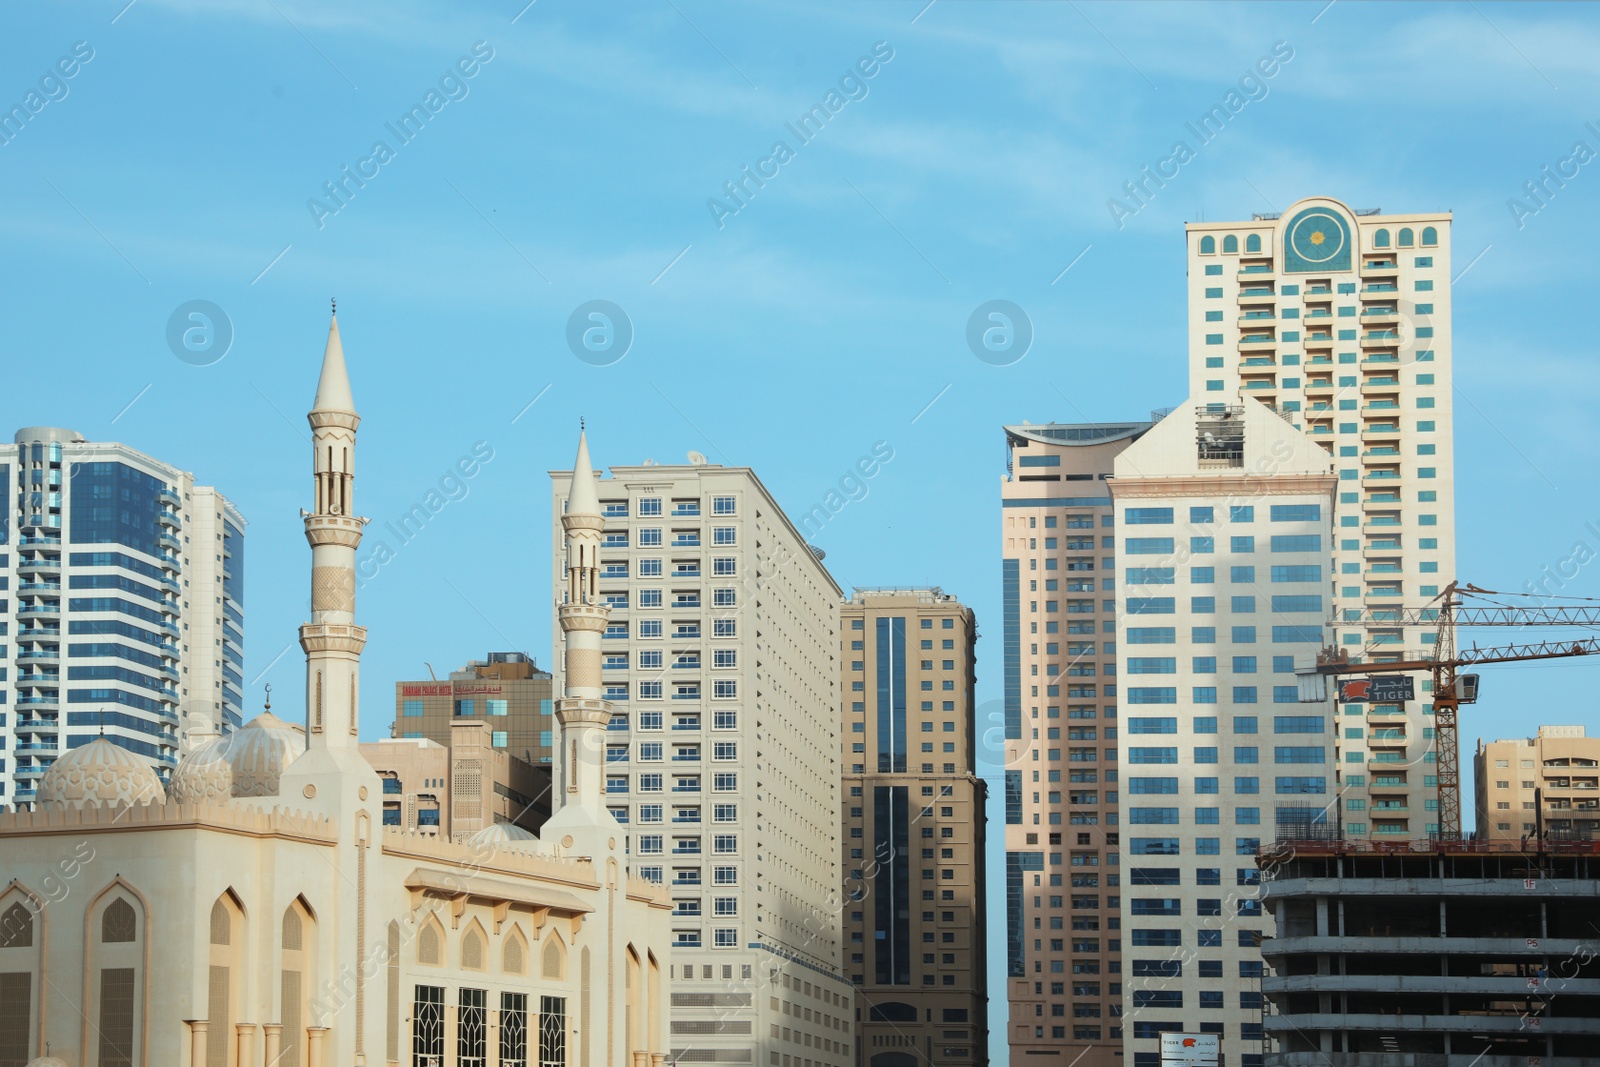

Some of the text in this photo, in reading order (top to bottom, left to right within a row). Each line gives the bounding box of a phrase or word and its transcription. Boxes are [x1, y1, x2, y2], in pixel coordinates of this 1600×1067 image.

[1374, 678, 1412, 691] تايجر
[439, 686, 452, 695] HOTEL
[1374, 690, 1412, 700] TIGER
[1525, 879, 1535, 888] 1F
[1526, 939, 1538, 947] P5
[1528, 1018, 1540, 1027] P3
[1528, 1057, 1540, 1065] P2
